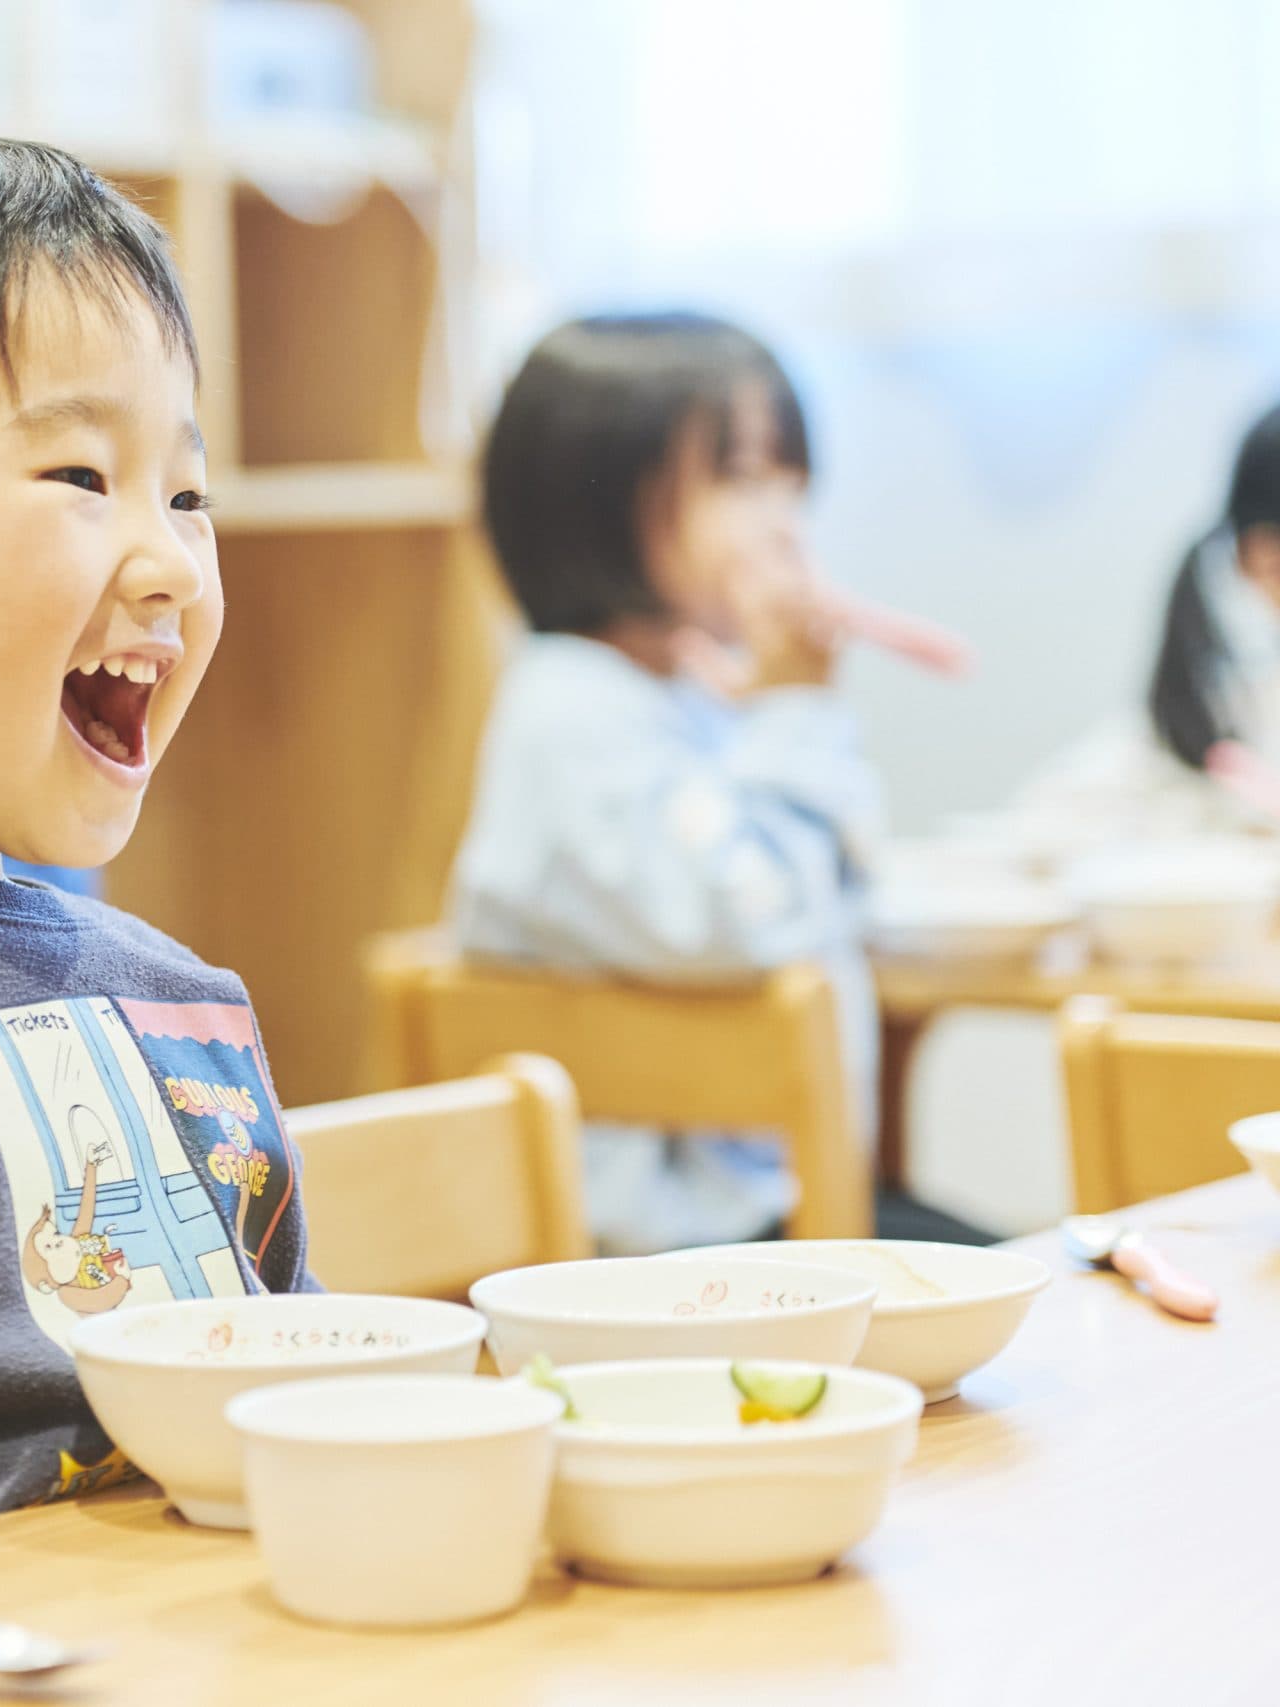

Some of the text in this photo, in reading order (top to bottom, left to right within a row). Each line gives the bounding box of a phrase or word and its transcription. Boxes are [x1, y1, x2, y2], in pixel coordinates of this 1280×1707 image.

[7, 1010, 69, 1035] Tickets
[164, 1077, 259, 1117] CURIOUS
[207, 1152, 271, 1197] GEORGE
